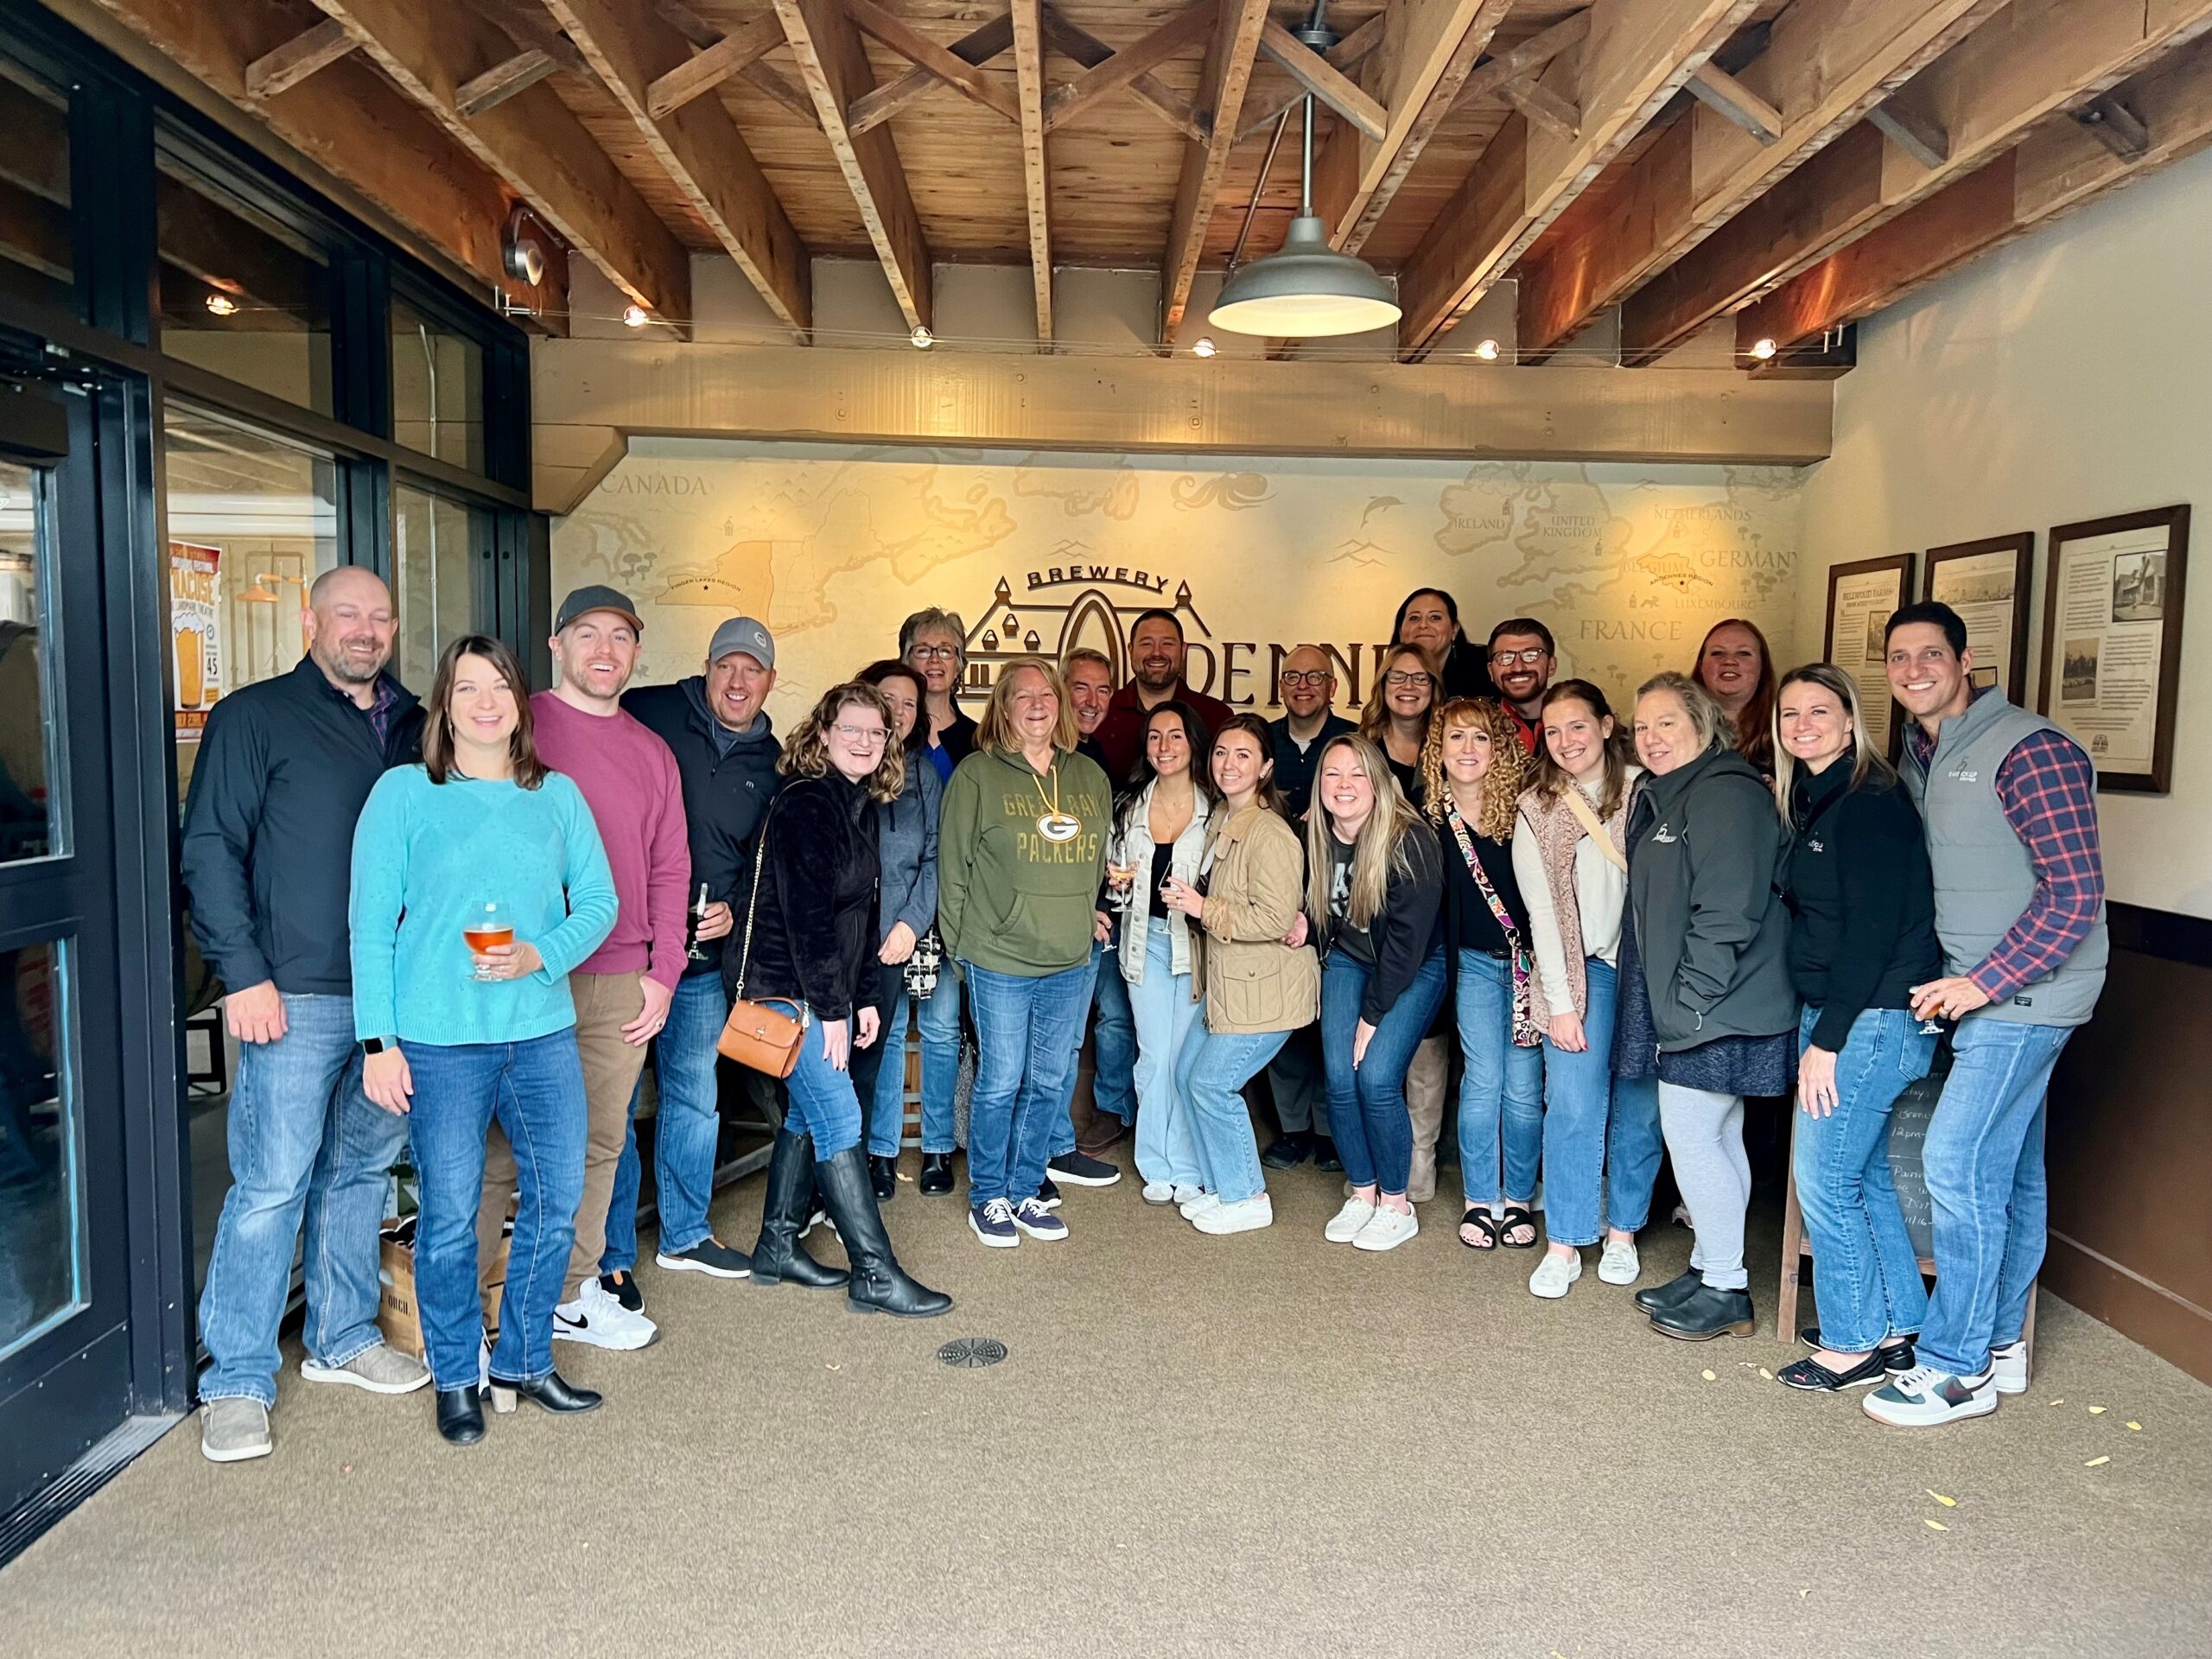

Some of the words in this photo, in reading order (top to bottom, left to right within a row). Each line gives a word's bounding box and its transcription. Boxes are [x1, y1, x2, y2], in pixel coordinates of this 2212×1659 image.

[601, 474, 709, 495] CANADA
[1552, 516, 1595, 526] UNITED
[1654, 508, 1752, 521] NETHERLANDS
[1453, 518, 1505, 530] IRELAND
[1543, 526, 1603, 537] KINGDOM
[1623, 562, 1683, 574] BELGIUM
[671, 578, 694, 590] FINGER
[716, 579, 741, 592] REGION
[1027, 565, 1169, 591] BREWERY
[1649, 574, 1687, 586] ARDENNES
[1688, 573, 1714, 587] REGION
[1675, 599, 1758, 610] LUXEMBOURG
[1580, 620, 1682, 641] FRANCE
[1066, 794, 1098, 817] BAY
[1016, 832, 1098, 864] PACKERS
